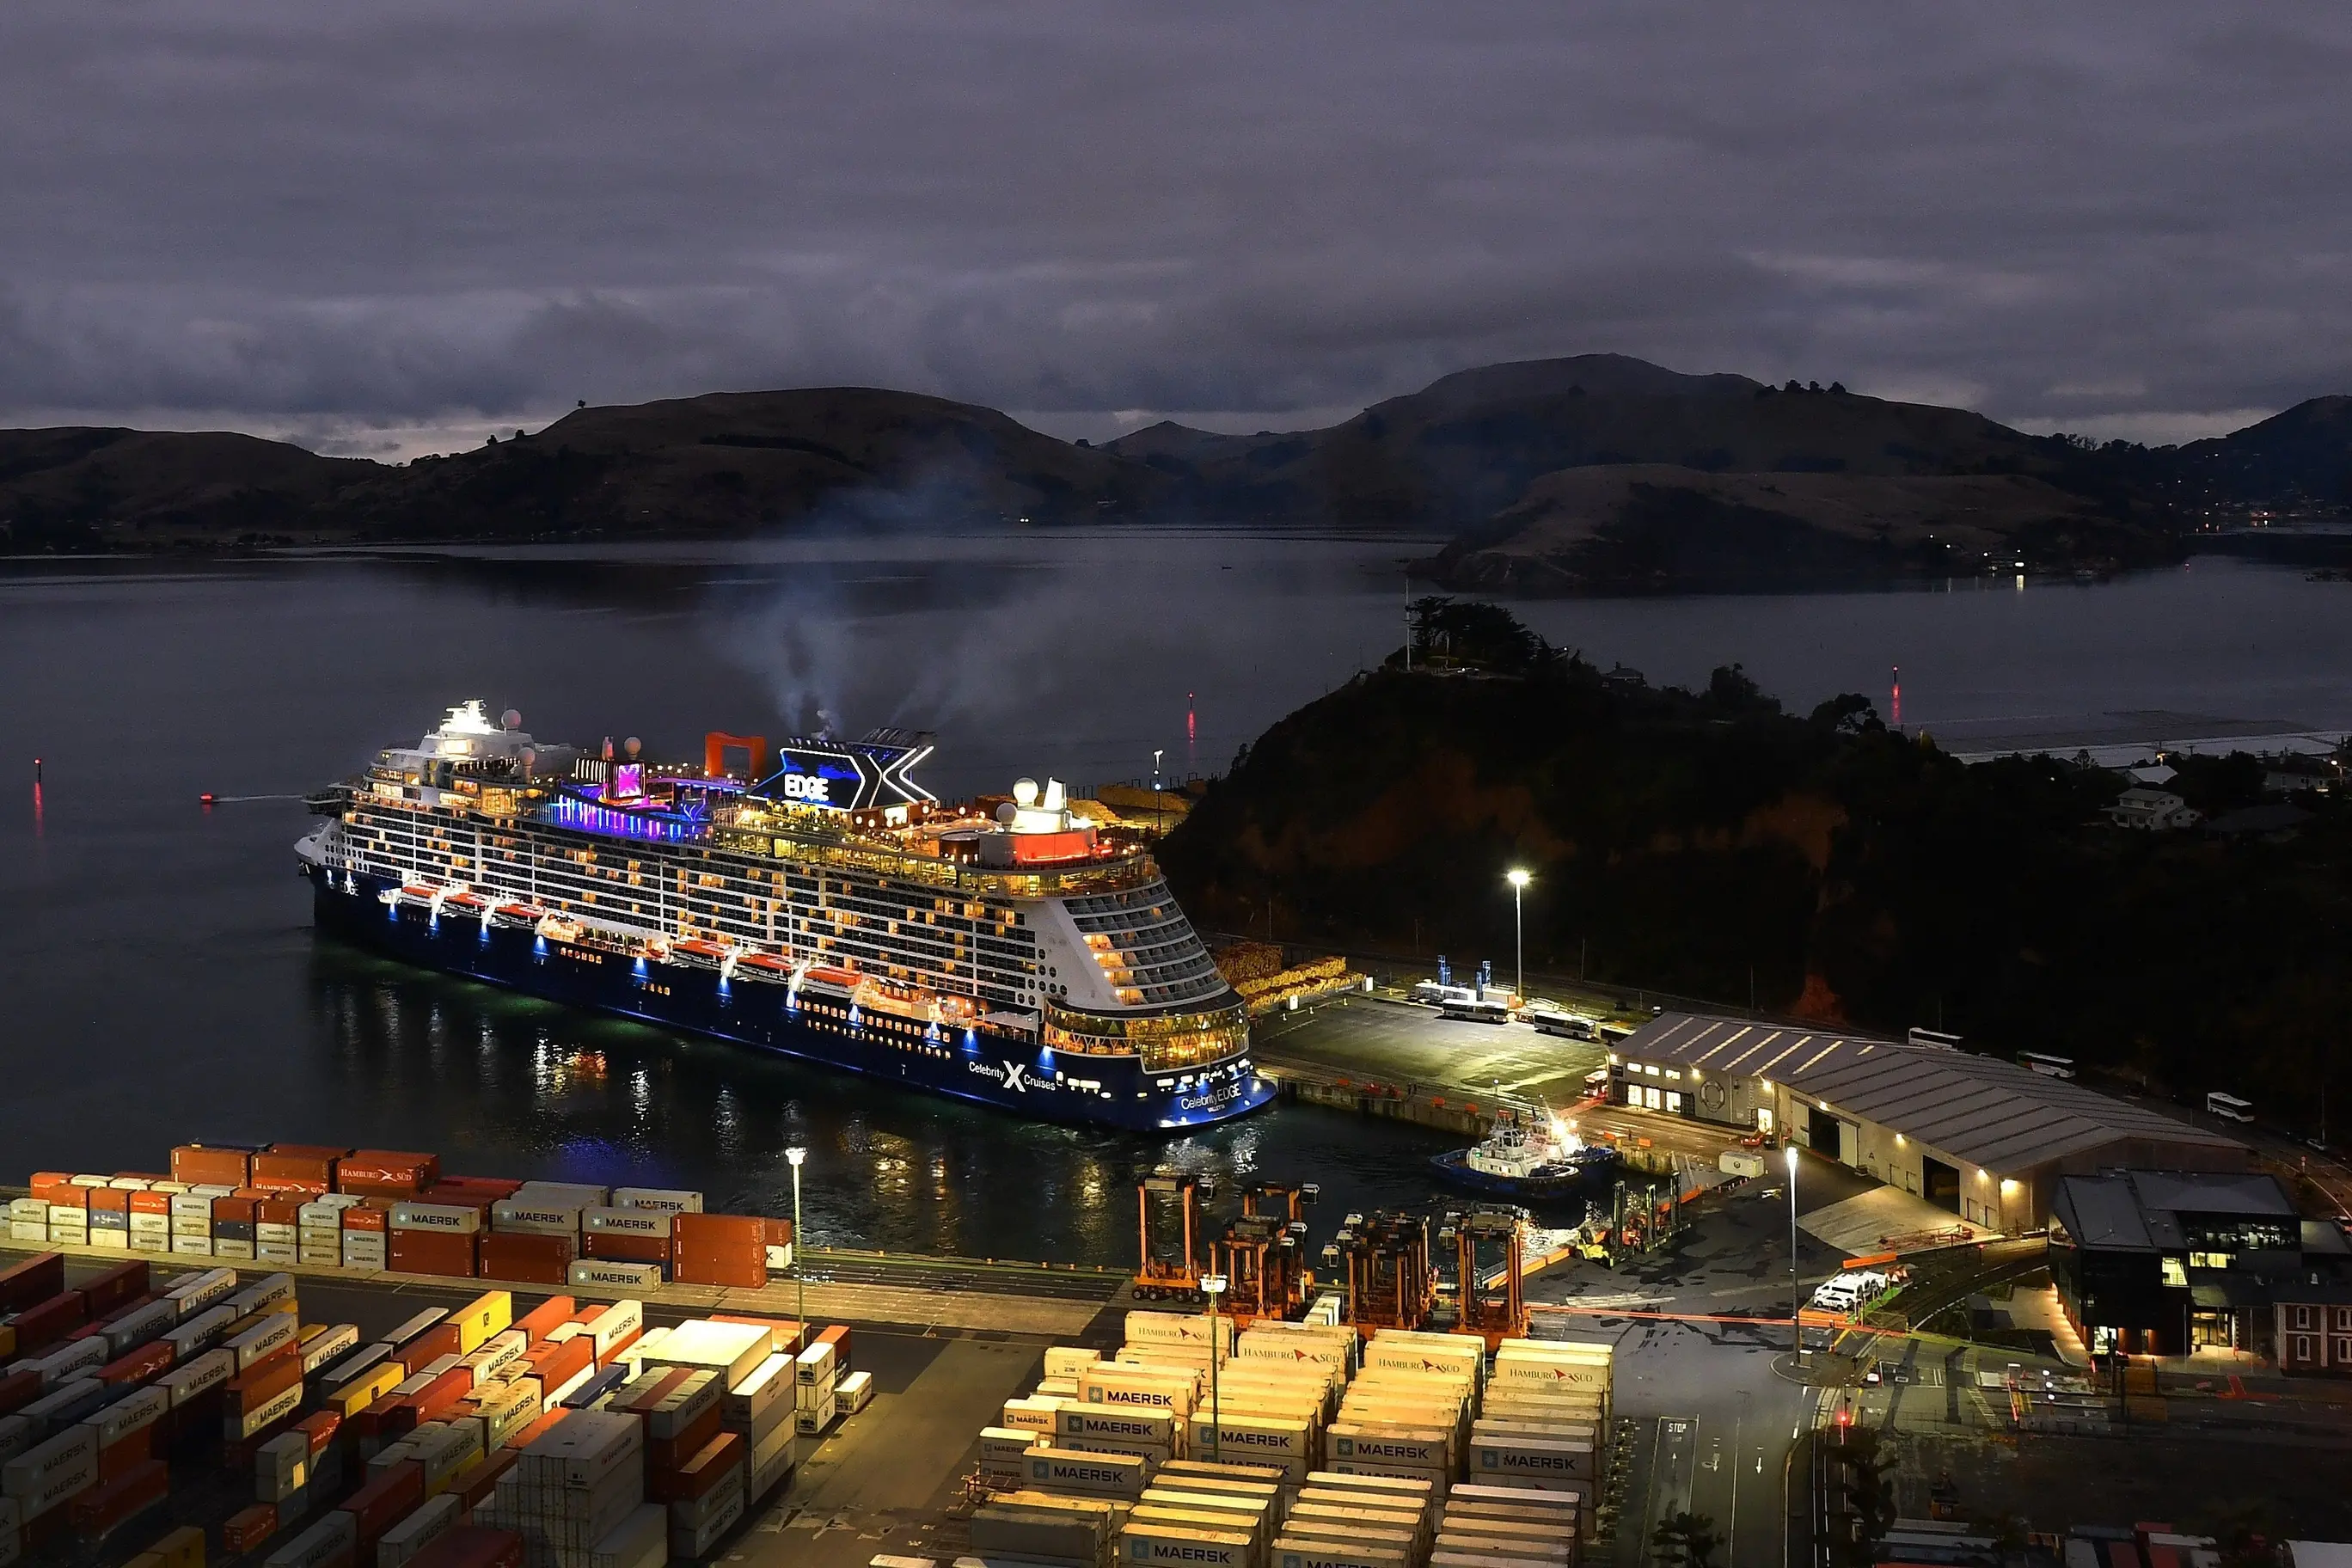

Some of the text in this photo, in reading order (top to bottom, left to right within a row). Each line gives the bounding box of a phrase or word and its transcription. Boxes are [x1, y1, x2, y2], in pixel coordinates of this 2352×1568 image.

[785, 774, 829, 800] EDGE
[968, 1061, 1005, 1081] Celebrity
[1024, 1074, 1056, 1091] Cruises
[1180, 1082, 1241, 1110] Celebrity EDGE
[341, 1168, 379, 1179] HAMBURG
[634, 1199, 684, 1211] MAERSK
[412, 1214, 460, 1227] MAERSK
[516, 1211, 565, 1224] MAERSK
[606, 1218, 656, 1230] MAERSK
[591, 1271, 642, 1284] MAERSK
[195, 1279, 230, 1304] MAERSK
[254, 1284, 288, 1307] MAERSK
[132, 1312, 169, 1336] MAERSK
[194, 1319, 229, 1344] MAERSK
[609, 1314, 636, 1340] MAERSK
[1138, 1327, 1180, 1338] HAMBURG
[254, 1325, 291, 1353] MAERSK
[318, 1337, 352, 1363] MAERSK
[488, 1344, 520, 1373] MAERSK
[1244, 1347, 1339, 1363] HAMBURG SÜD
[1379, 1358, 1460, 1373] HAMBURG SÜD
[189, 1362, 227, 1390] MAERSK
[1510, 1369, 1593, 1383] HAMBURG SÜD
[260, 1393, 297, 1423] MAERSK
[504, 1392, 535, 1423] MAERSK
[685, 1388, 715, 1417] MAERSK
[1107, 1390, 1173, 1406] MAERSK
[119, 1399, 160, 1430] MAERSK
[1016, 1416, 1049, 1424] MAERSK
[1086, 1419, 1153, 1436] MAERSK
[1221, 1430, 1289, 1448] MAERSK
[43, 1442, 87, 1472] MAERSK
[442, 1433, 476, 1465] MAERSK
[1358, 1443, 1429, 1460] MAERSK
[1504, 1454, 1576, 1470] MAERSK
[43, 1468, 87, 1502] MAERSK
[1054, 1465, 1124, 1483] MAERSK
[1155, 1545, 1230, 1563] MAERSK
